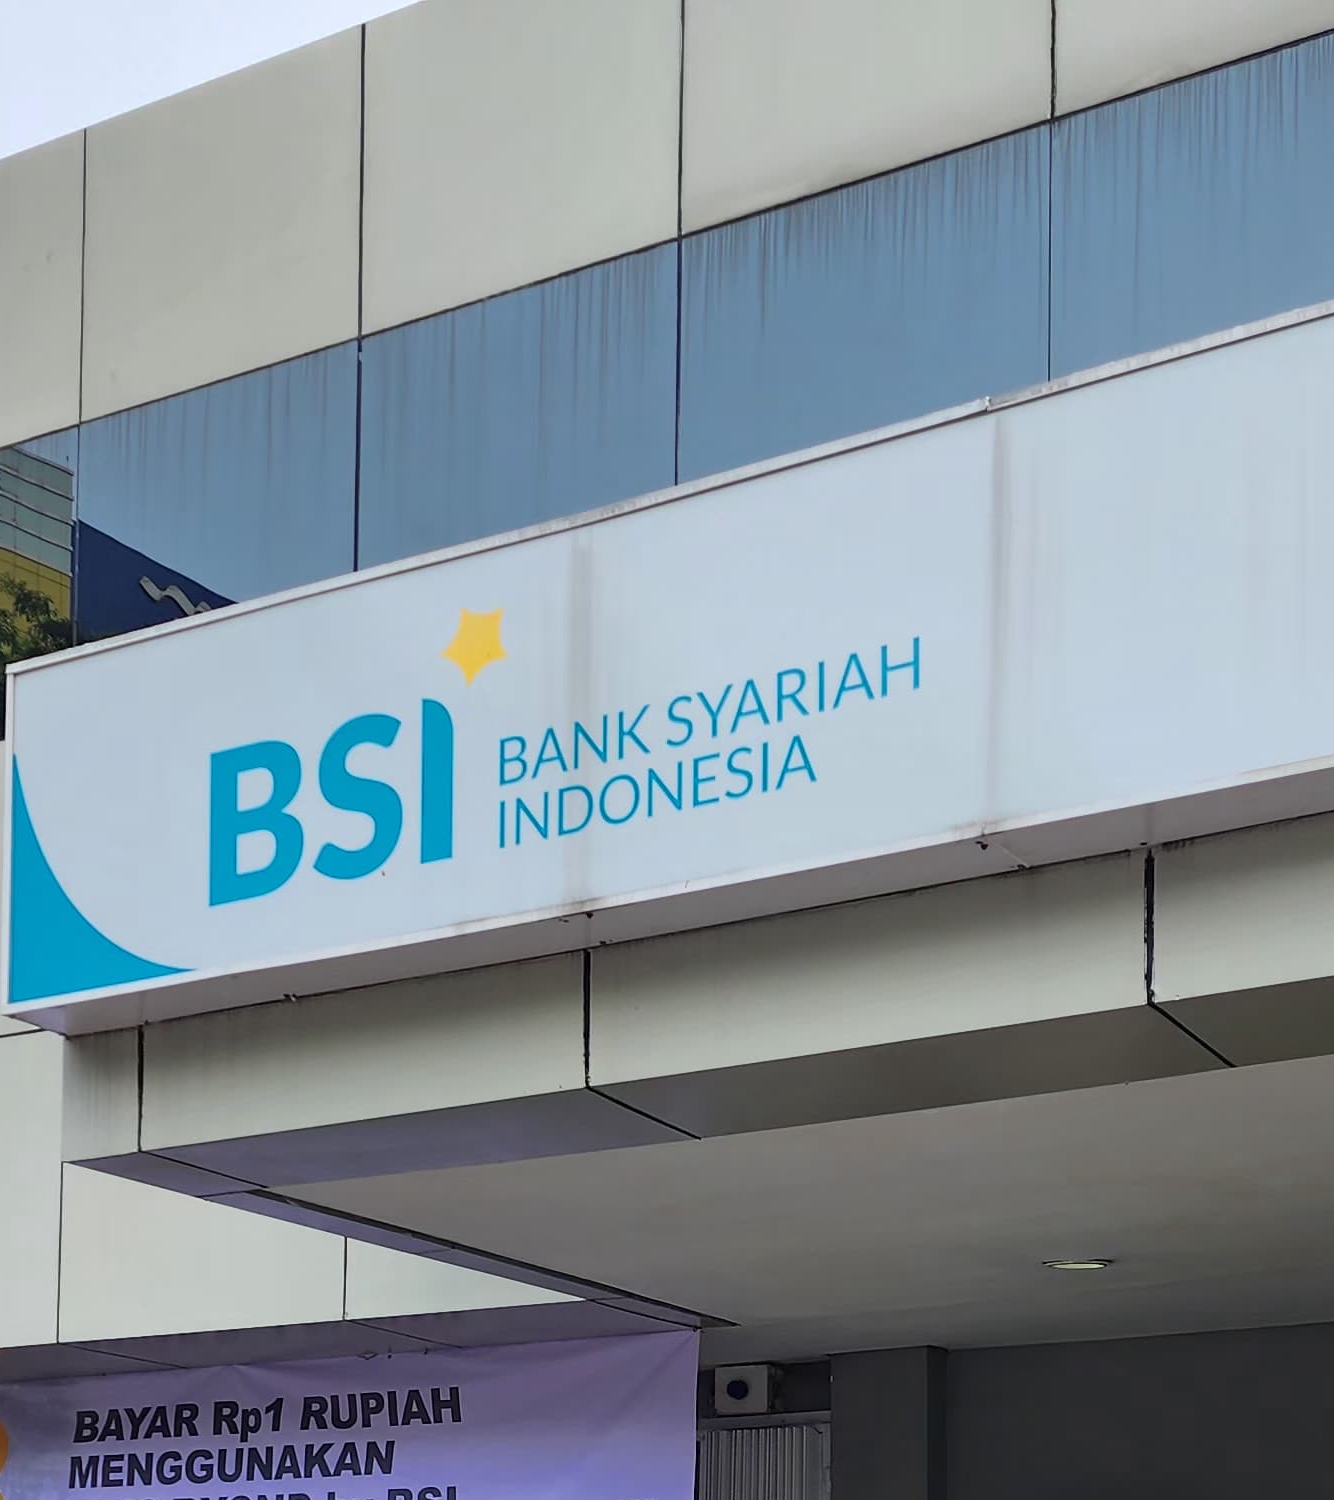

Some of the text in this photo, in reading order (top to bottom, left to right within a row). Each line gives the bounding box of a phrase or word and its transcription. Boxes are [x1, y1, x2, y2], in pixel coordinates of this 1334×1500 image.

[497, 635, 922, 786] BANK SYARIAH
[208, 698, 455, 908] BSI
[497, 734, 818, 850] INDONESIA
[68, 1440, 396, 1489] MENGGUNAKAN
[73, 1386, 463, 1444] BAYAR Rp1 RUPIAH
